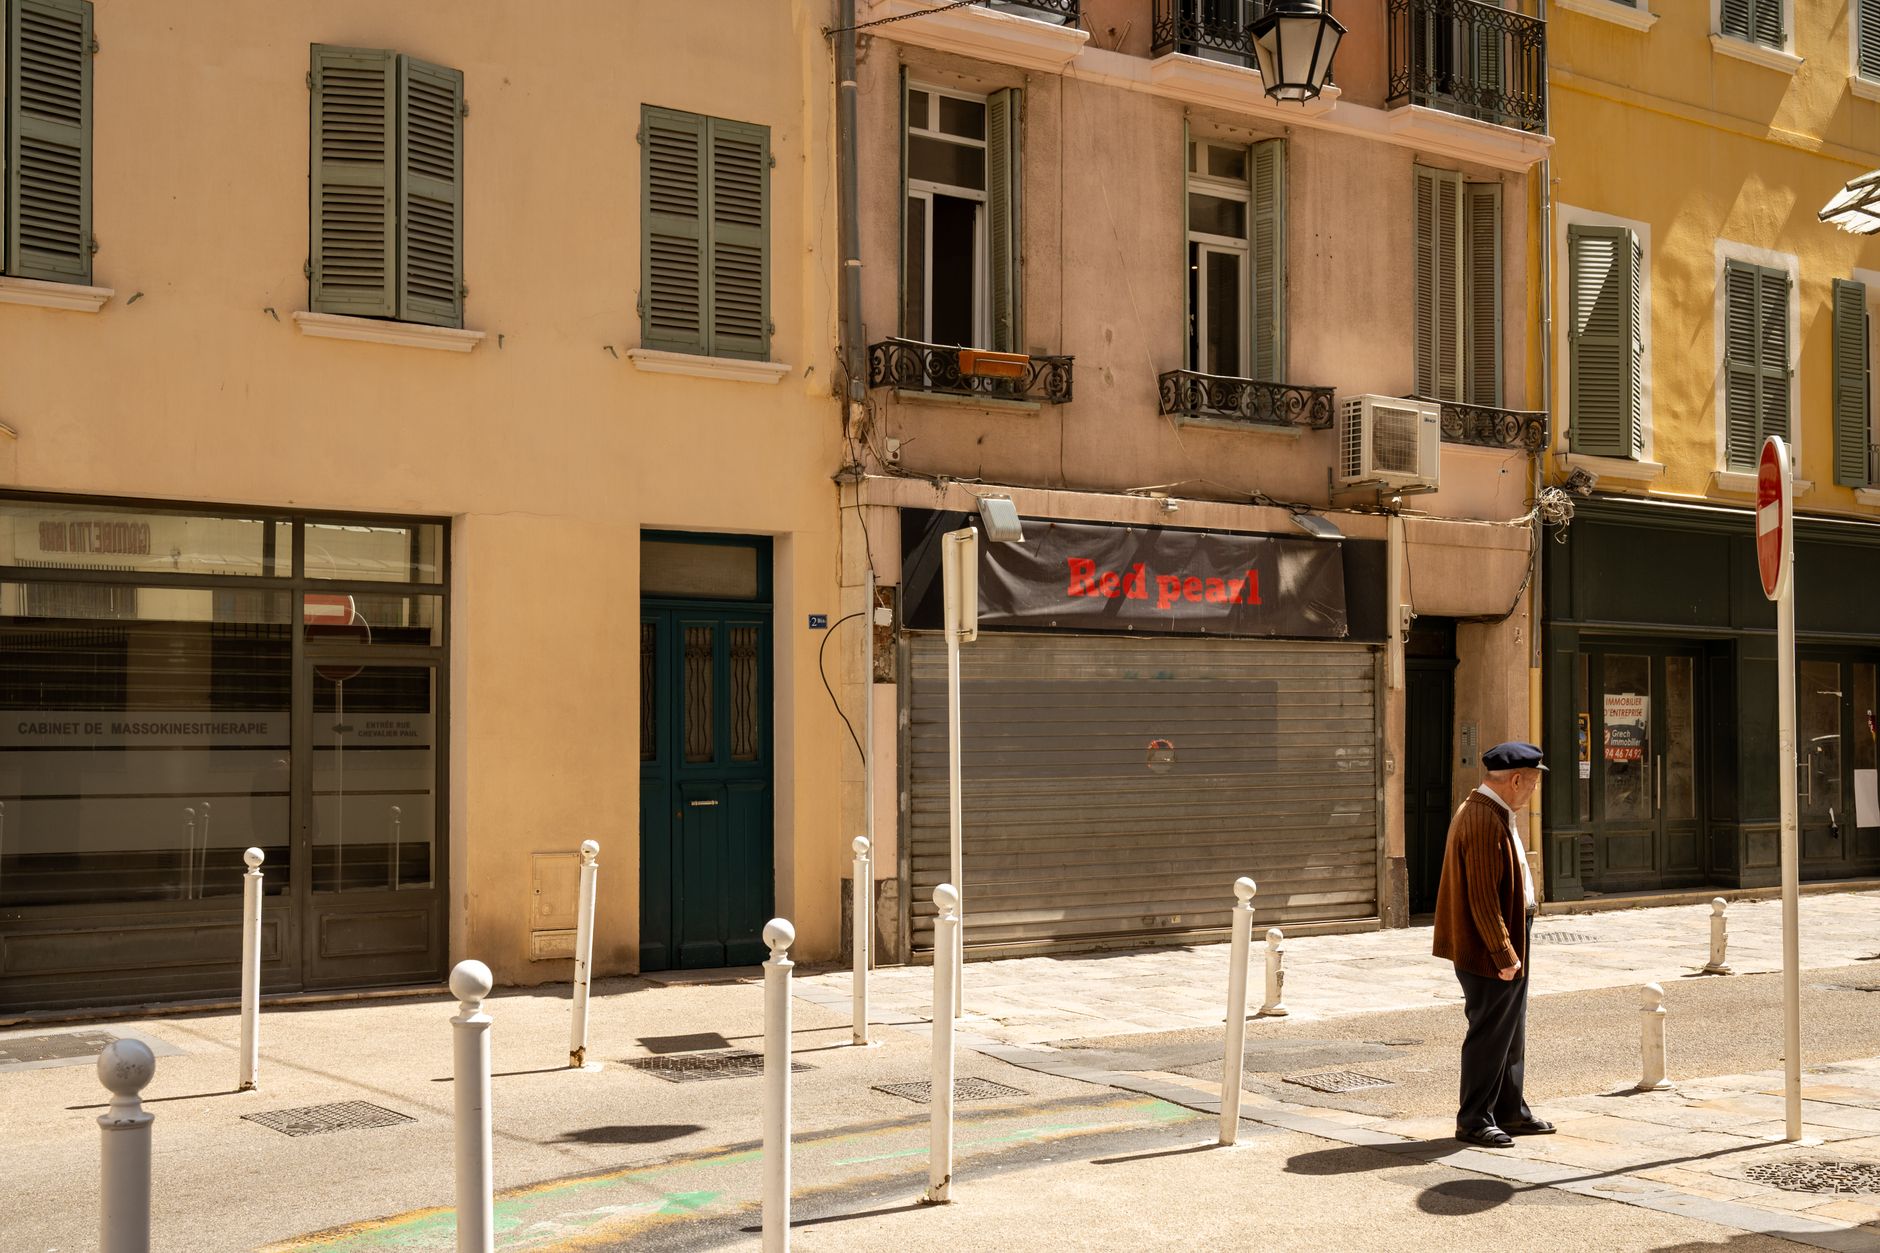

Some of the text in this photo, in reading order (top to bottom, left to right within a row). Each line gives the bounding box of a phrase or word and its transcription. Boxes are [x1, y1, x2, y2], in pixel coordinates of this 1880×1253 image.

[1067, 556, 1263, 610] Red pearl
[810, 617, 817, 627] 2
[1606, 697, 1642, 706] IMMOBILIER
[17, 721, 269, 736] CABINET DE MASSOKINESITHERAPIE
[1612, 729, 1631, 738] Grech
[1615, 748, 1624, 759] 46
[1626, 748, 1634, 759] 74
